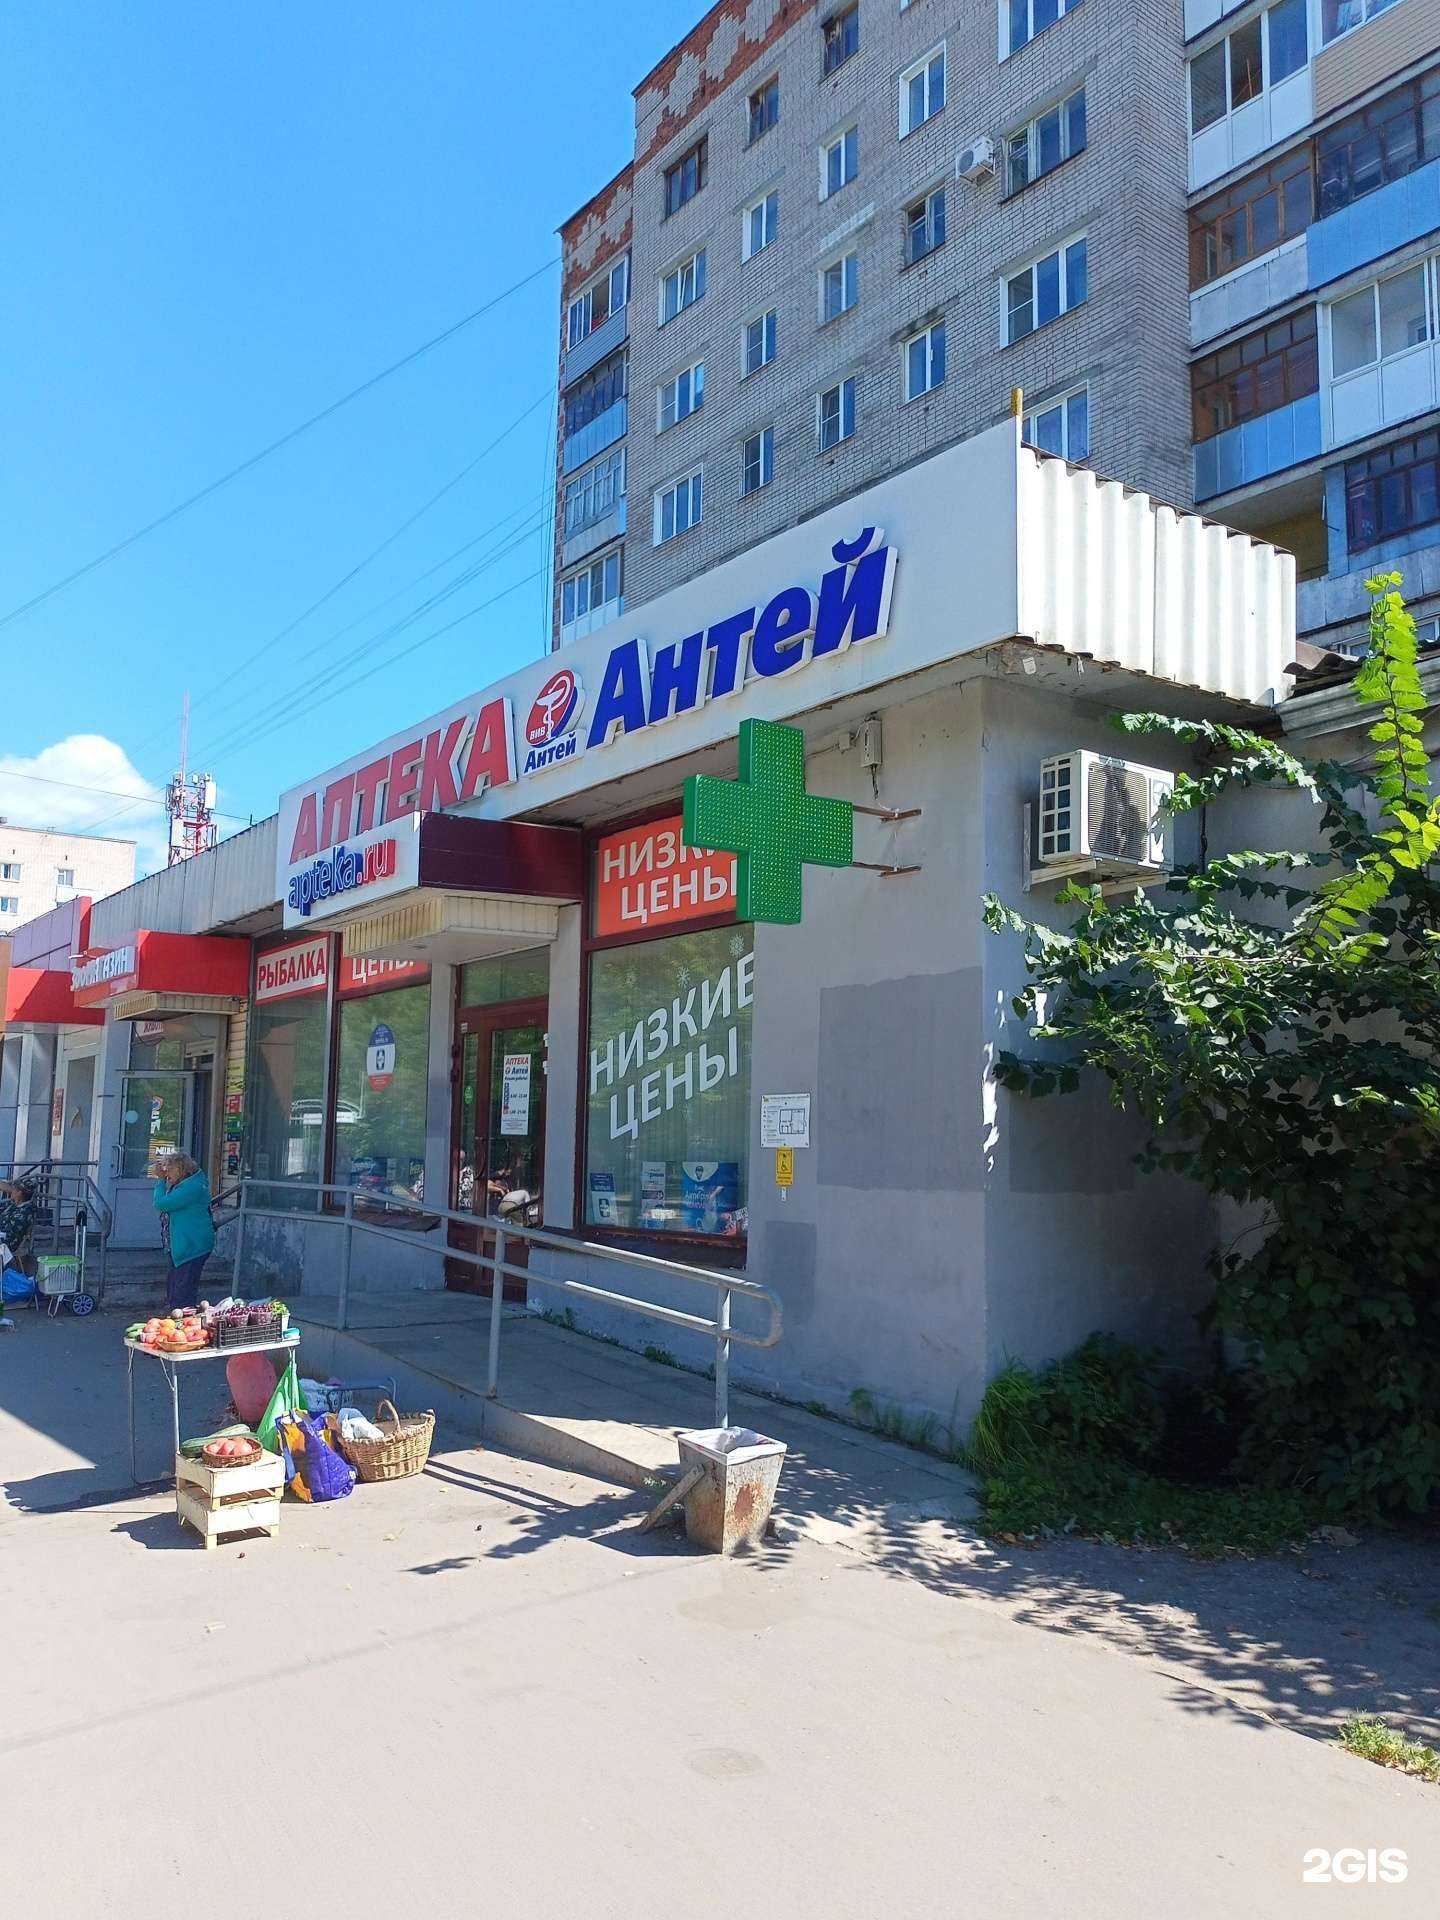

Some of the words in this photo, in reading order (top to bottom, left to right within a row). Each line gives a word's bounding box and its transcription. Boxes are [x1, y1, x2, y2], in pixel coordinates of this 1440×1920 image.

[586, 526, 896, 749] Антей
[289, 697, 516, 866] АПТЕКА
[523, 731, 577, 774] Антей
[288, 839, 396, 916] apteka.ru
[603, 827, 717, 883] НИЗК
[621, 859, 738, 924] ЦЕНЫ
[258, 947, 326, 991] РЫБАЛКА
[590, 951, 754, 1096] НИЗКИЕ
[505, 1057, 529, 1066] АПТЕКА
[610, 1026, 738, 1141] ЦЕНЫ
